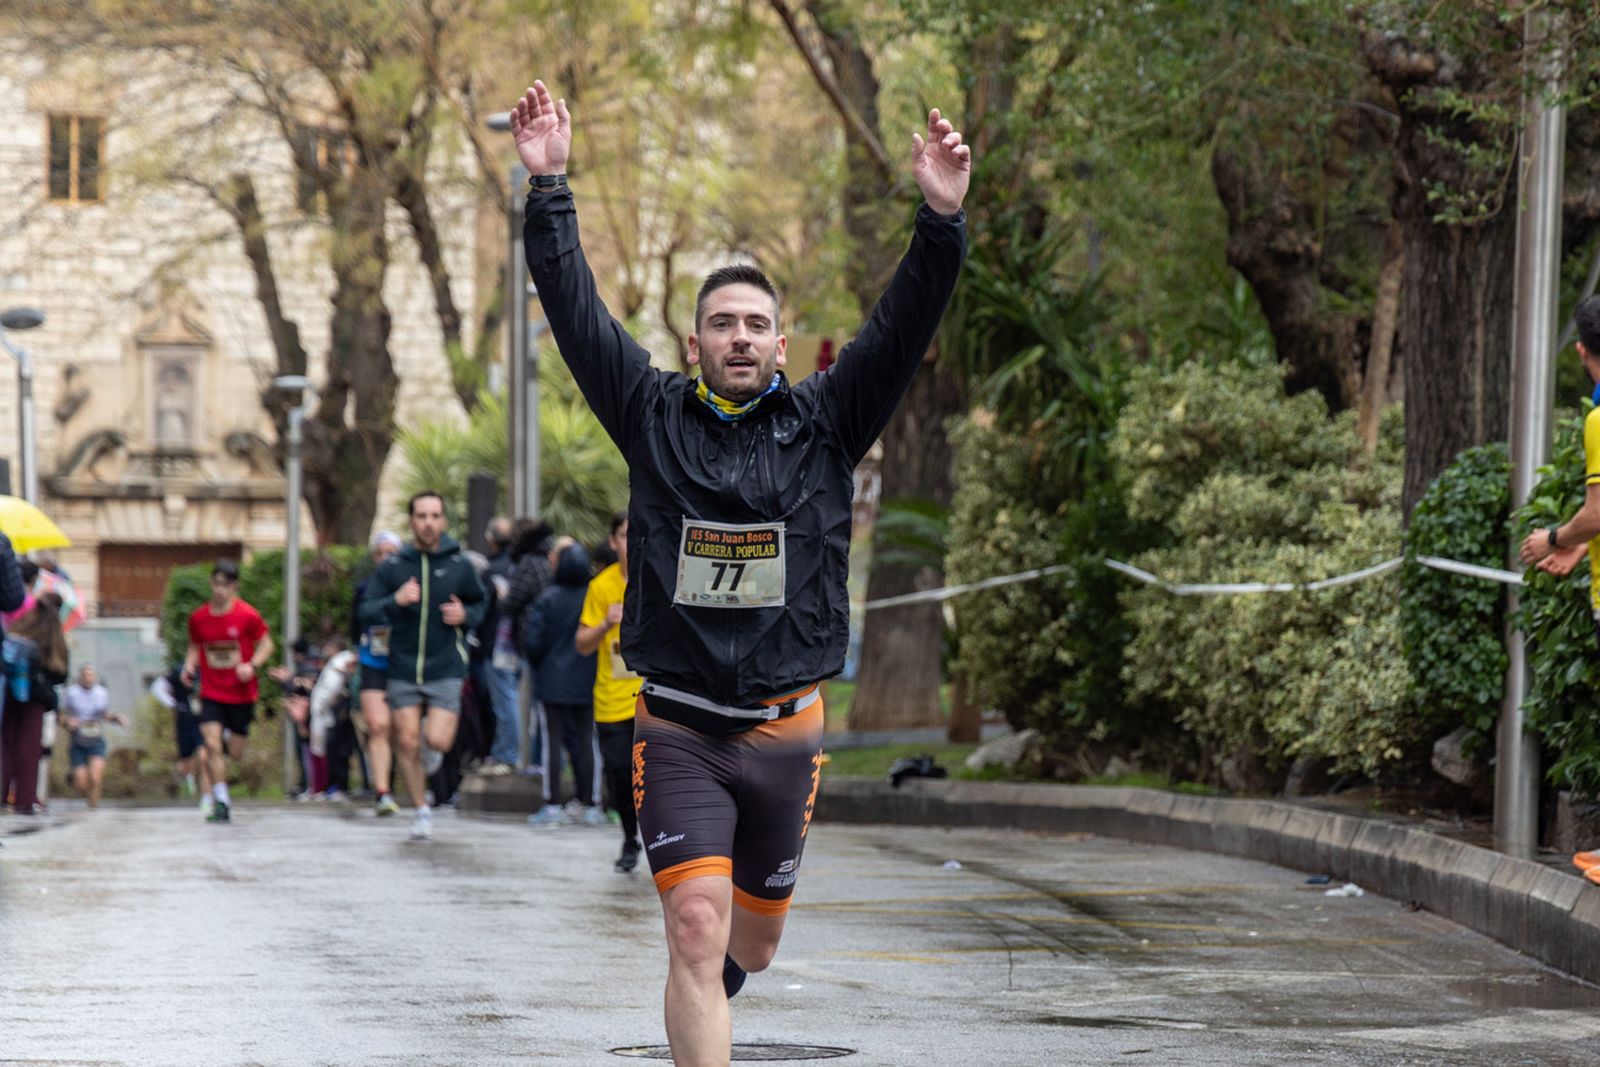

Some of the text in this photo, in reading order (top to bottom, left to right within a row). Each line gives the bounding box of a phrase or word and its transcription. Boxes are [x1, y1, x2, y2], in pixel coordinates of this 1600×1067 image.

[691, 530, 773, 543] IES San Juan Bosco
[687, 542, 776, 558] V CARRERA POPULAR
[711, 562, 746, 591] 77
